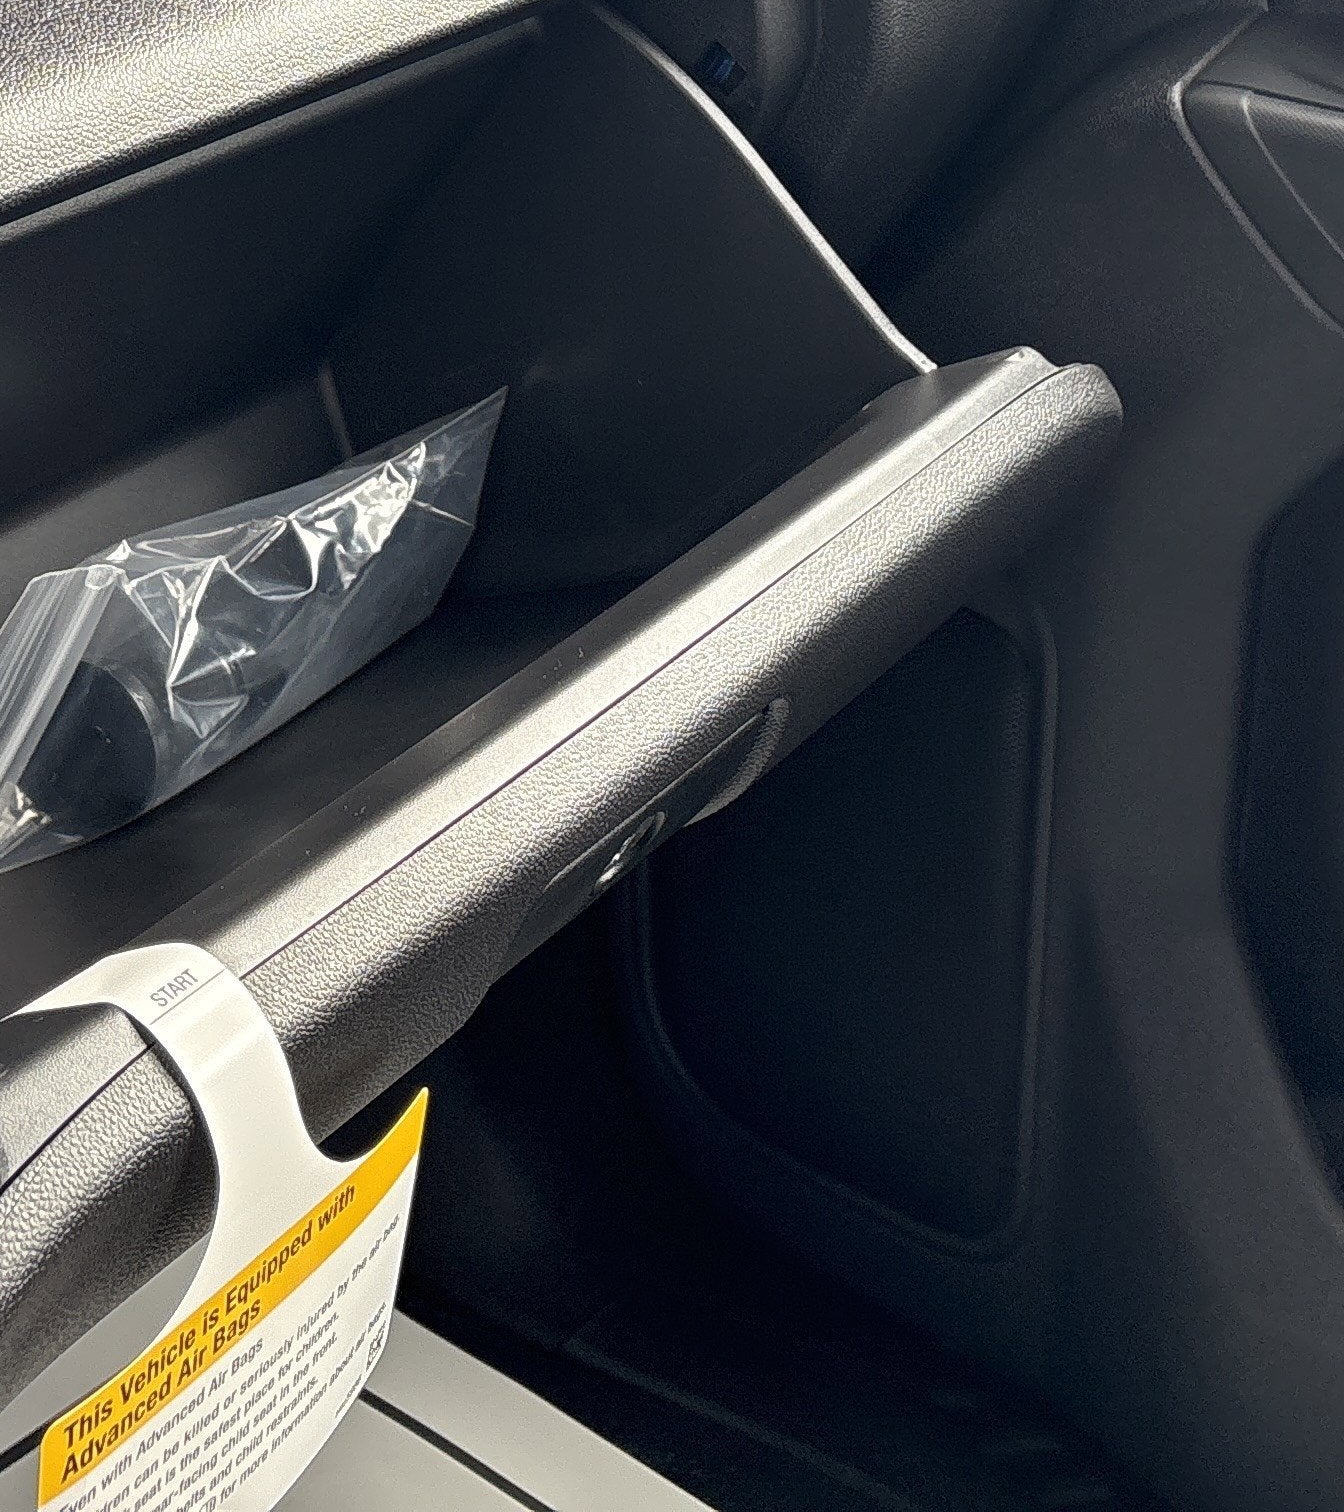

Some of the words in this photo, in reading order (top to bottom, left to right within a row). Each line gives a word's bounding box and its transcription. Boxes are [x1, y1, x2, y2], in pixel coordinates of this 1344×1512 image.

[149, 968, 199, 1007] START
[60, 1372, 172, 1485] Advanced
[177, 1345, 208, 1387] Air
[213, 1299, 261, 1355] Bags
[63, 1399, 114, 1449] This
[120, 1328, 196, 1405] Vehicle
[202, 1307, 219, 1336] is
[225, 1220, 313, 1316] Equipped
[317, 1185, 355, 1231] with
[134, 1459, 159, 1489] can
[163, 1441, 180, 1464] be
[184, 1402, 220, 1446] killed
[224, 1389, 237, 1411] or
[240, 1335, 294, 1395] seriously
[297, 1291, 334, 1341] injured
[337, 1277, 349, 1299] by
[351, 1256, 367, 1281] the
[221, 1420, 250, 1457] child
[253, 1394, 277, 1427] seat
[280, 1384, 289, 1401] in
[293, 1363, 309, 1387] the
[312, 1332, 337, 1366] front.
[101, 1454, 133, 1491] with
[136, 1387, 205, 1461] Advanced
[207, 1369, 229, 1397] Air
[231, 1338, 263, 1377] Bags
[165, 1466, 176, 1485] is
[180, 1445, 200, 1472] the
[204, 1406, 241, 1451] safest
[244, 1377, 275, 1417] place
[278, 1358, 293, 1381] for
[296, 1312, 339, 1363] children.
[210, 1458, 232, 1491] and
[235, 1429, 263, 1467] child
[266, 1376, 318, 1437] restraints.
[220, 1479, 237, 1504] for
[240, 1449, 268, 1485] more
[271, 1383, 327, 1453] information
[329, 1346, 354, 1387] about
